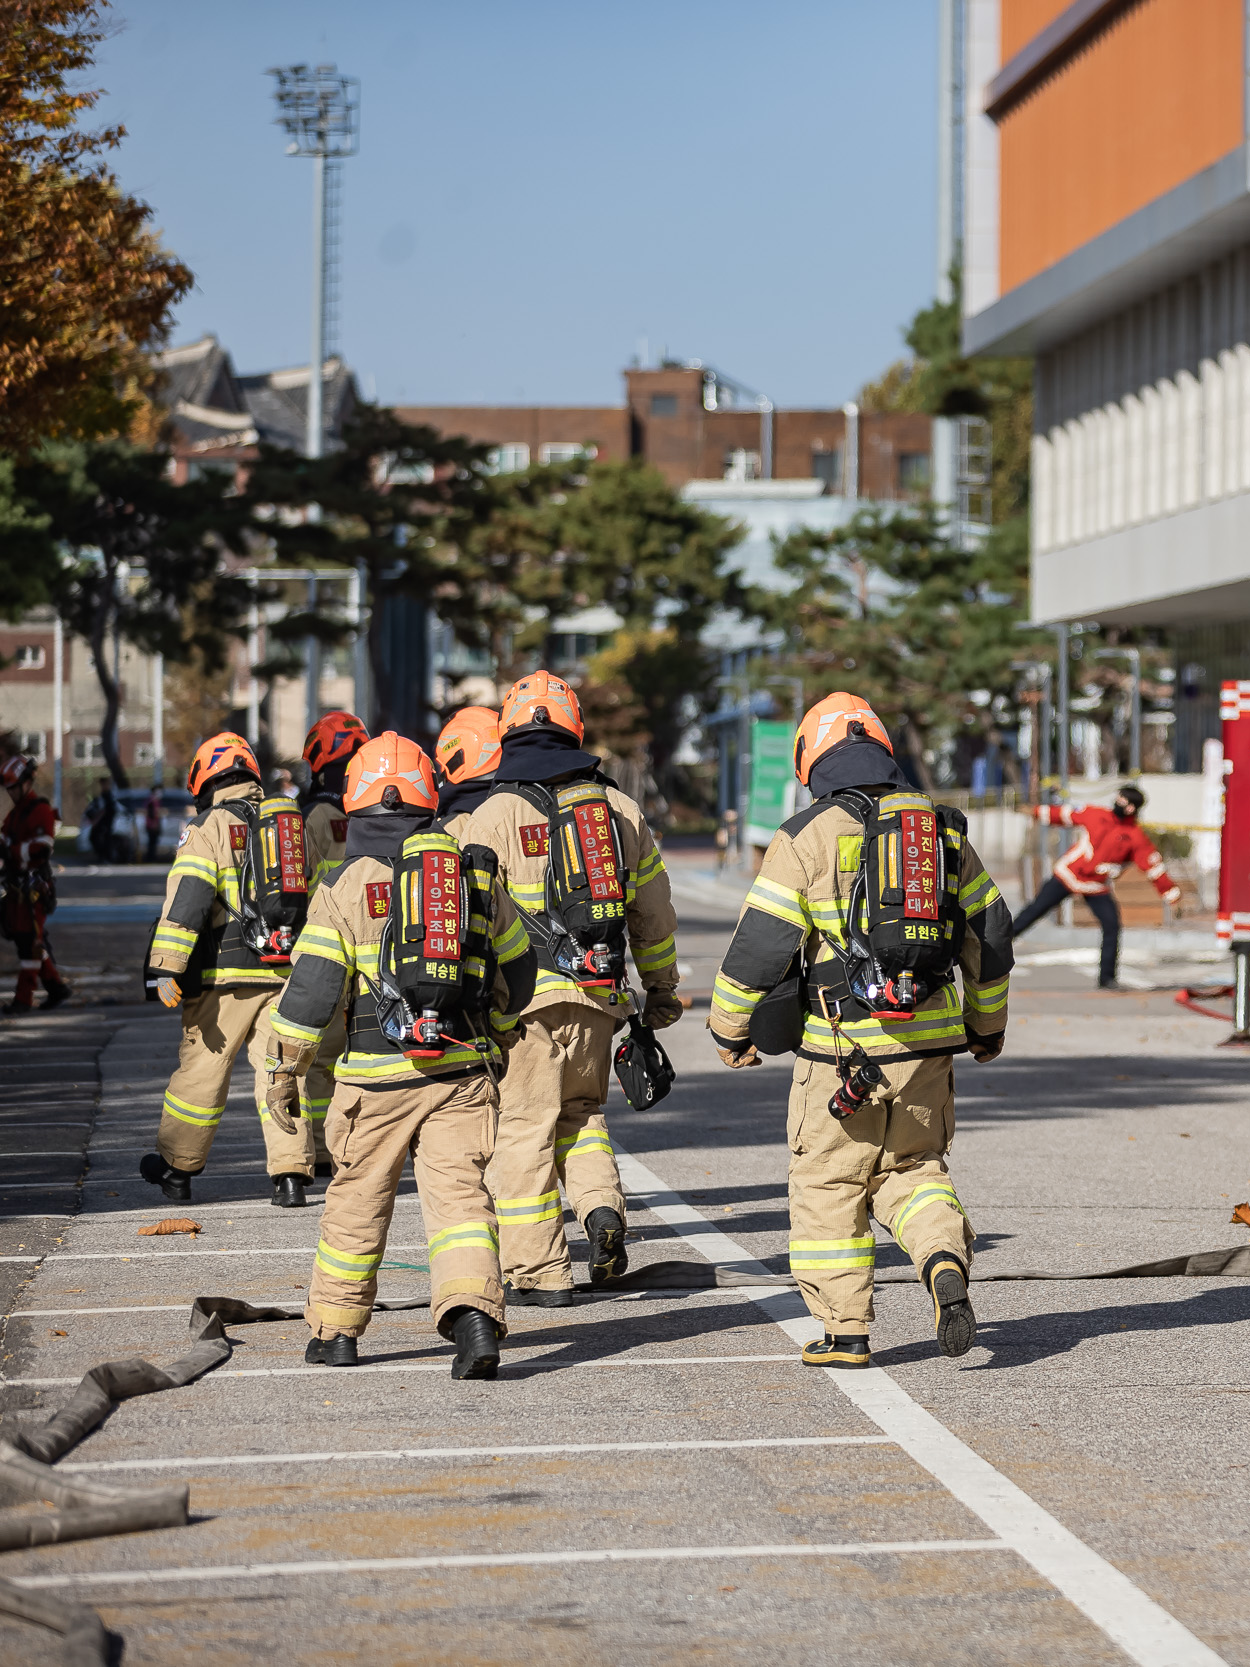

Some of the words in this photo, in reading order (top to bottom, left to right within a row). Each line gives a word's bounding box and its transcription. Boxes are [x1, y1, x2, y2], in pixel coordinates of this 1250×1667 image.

[282, 817, 296, 888] 119구조대
[291, 817, 306, 889] 광진소방서
[579, 810, 608, 896] 119구조대
[592, 806, 620, 894] 광진소방서
[906, 815, 922, 913] 119구조대
[920, 816, 935, 915] 광진소방서
[428, 856, 444, 953] 119구조대
[443, 857, 458, 956] 광진소방서
[591, 902, 625, 920] 장홍준
[904, 925, 939, 941] 김현우
[425, 962, 458, 981] 백승범
